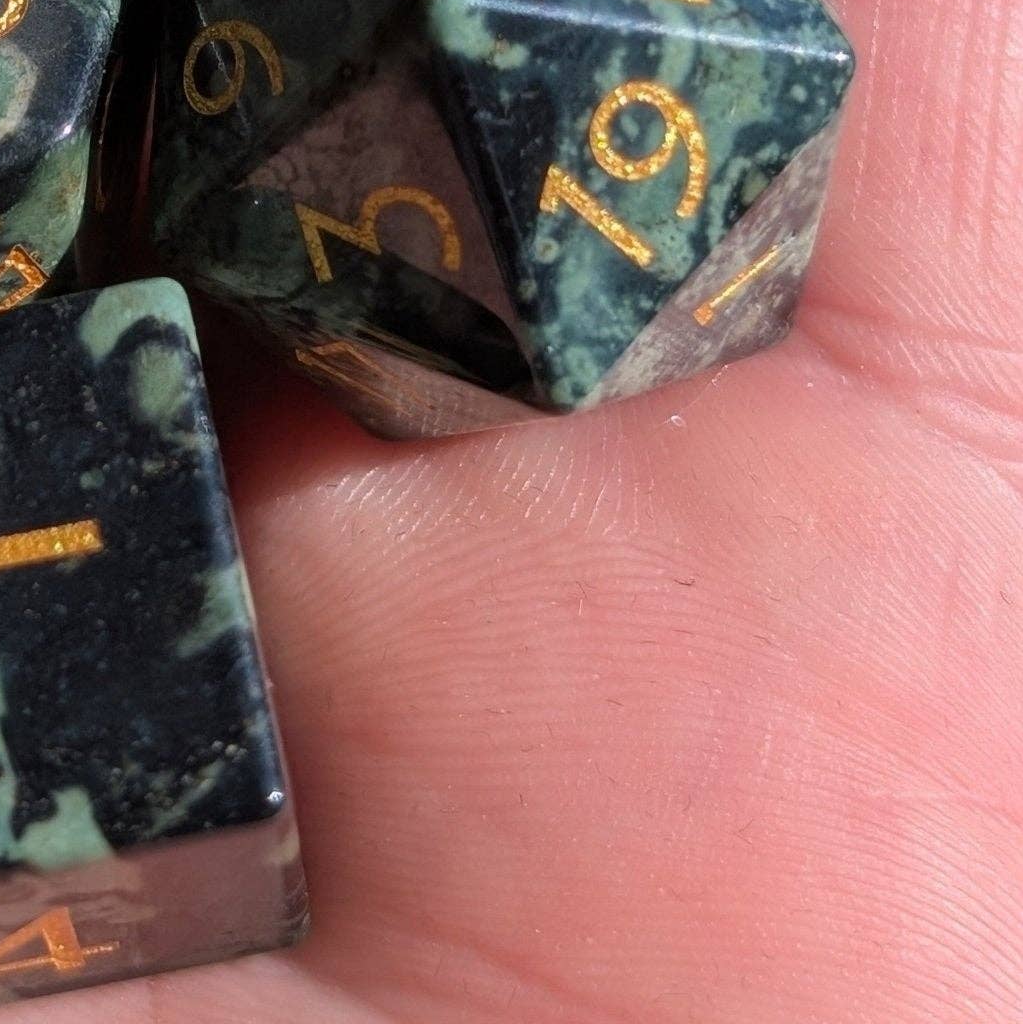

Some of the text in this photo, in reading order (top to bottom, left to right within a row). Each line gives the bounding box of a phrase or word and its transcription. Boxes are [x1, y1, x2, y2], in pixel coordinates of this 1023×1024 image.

[539, 80, 708, 268] 19
[295, 186, 462, 284] 3
[692, 244, 779, 327] 1
